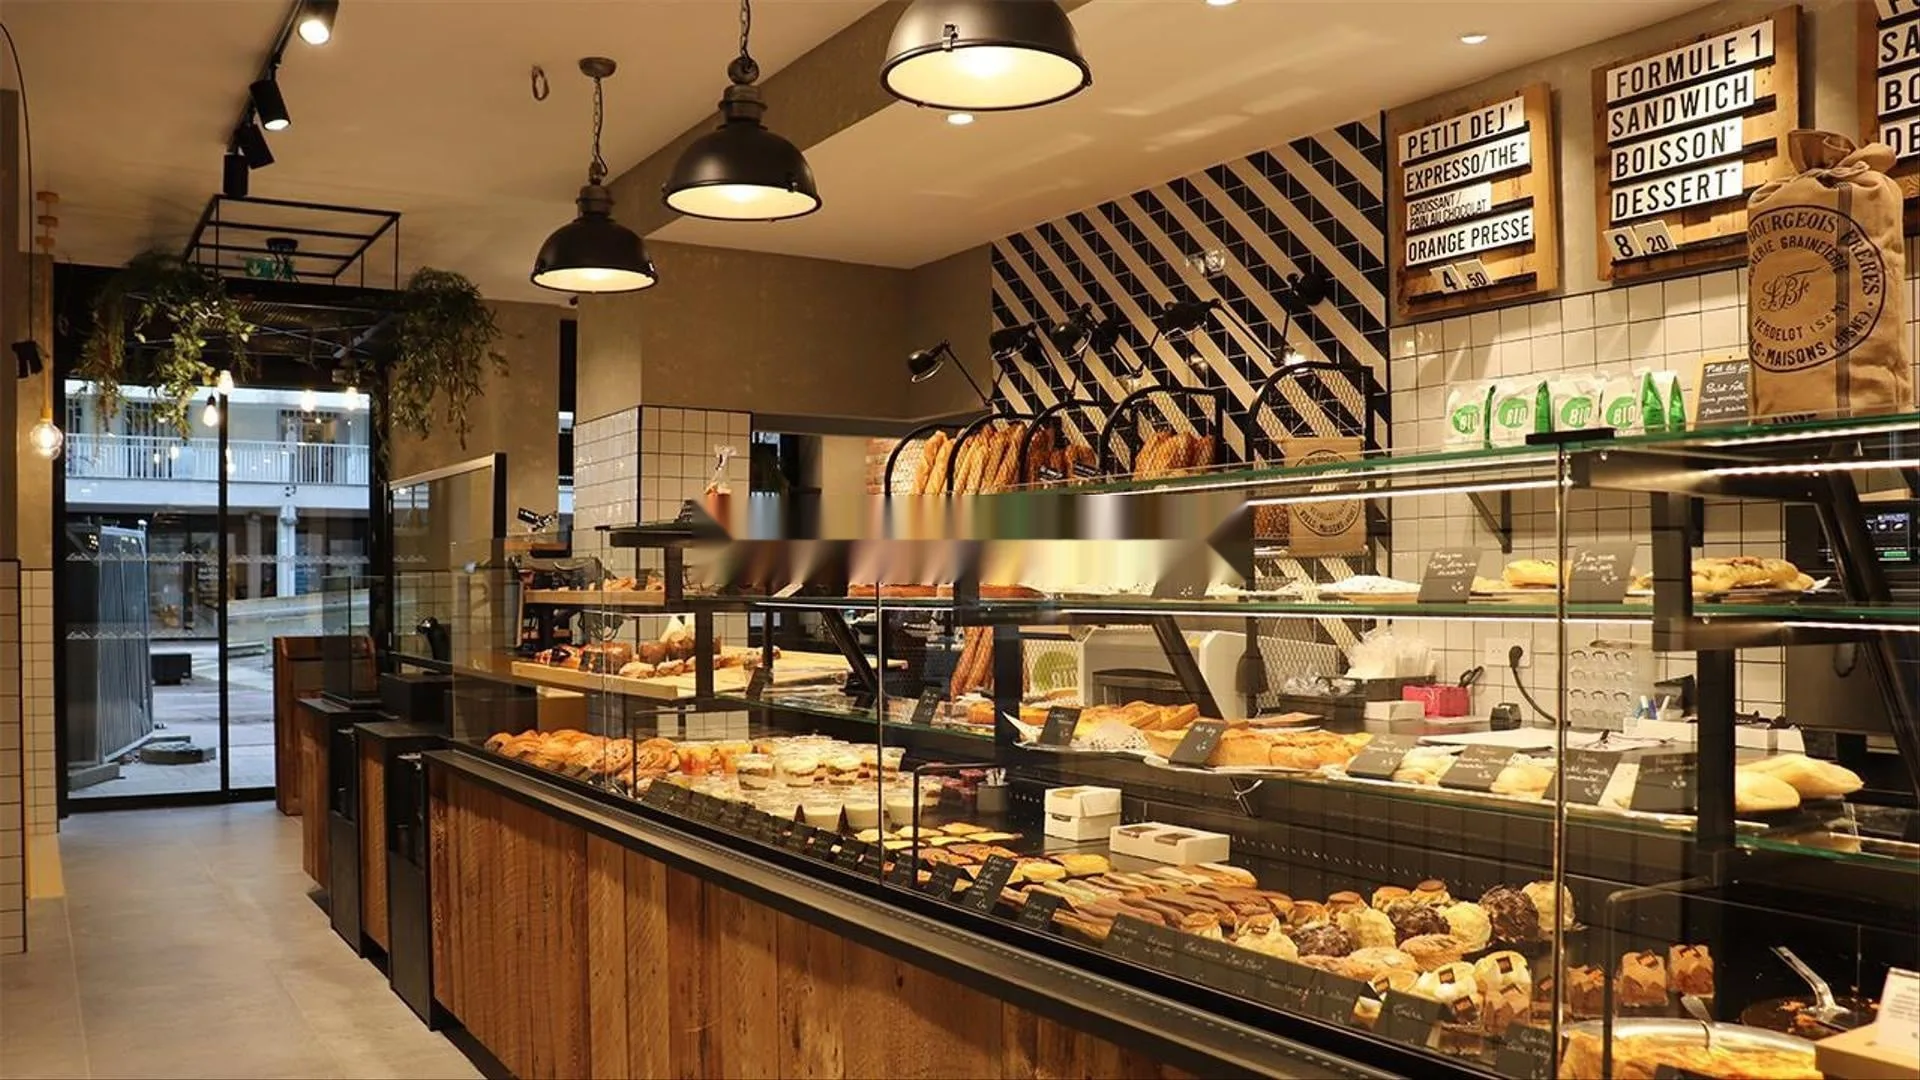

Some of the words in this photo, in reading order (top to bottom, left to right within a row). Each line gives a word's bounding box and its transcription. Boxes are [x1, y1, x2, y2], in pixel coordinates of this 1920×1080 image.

[1617, 37, 1737, 98] FORMULE
[1750, 29, 1762, 58] 1
[1612, 76, 1748, 137] SANDWICH
[1408, 121, 1461, 158] PETIT
[1470, 104, 1513, 140] DEJ'
[1409, 230, 1465, 262] ORANGE
[1471, 215, 1529, 248] PRESSE
[1458, 413, 1480, 430] BIO
[1505, 406, 1528, 424] BIO
[1568, 406, 1592, 425] BIO
[1613, 405, 1636, 425] BIO
